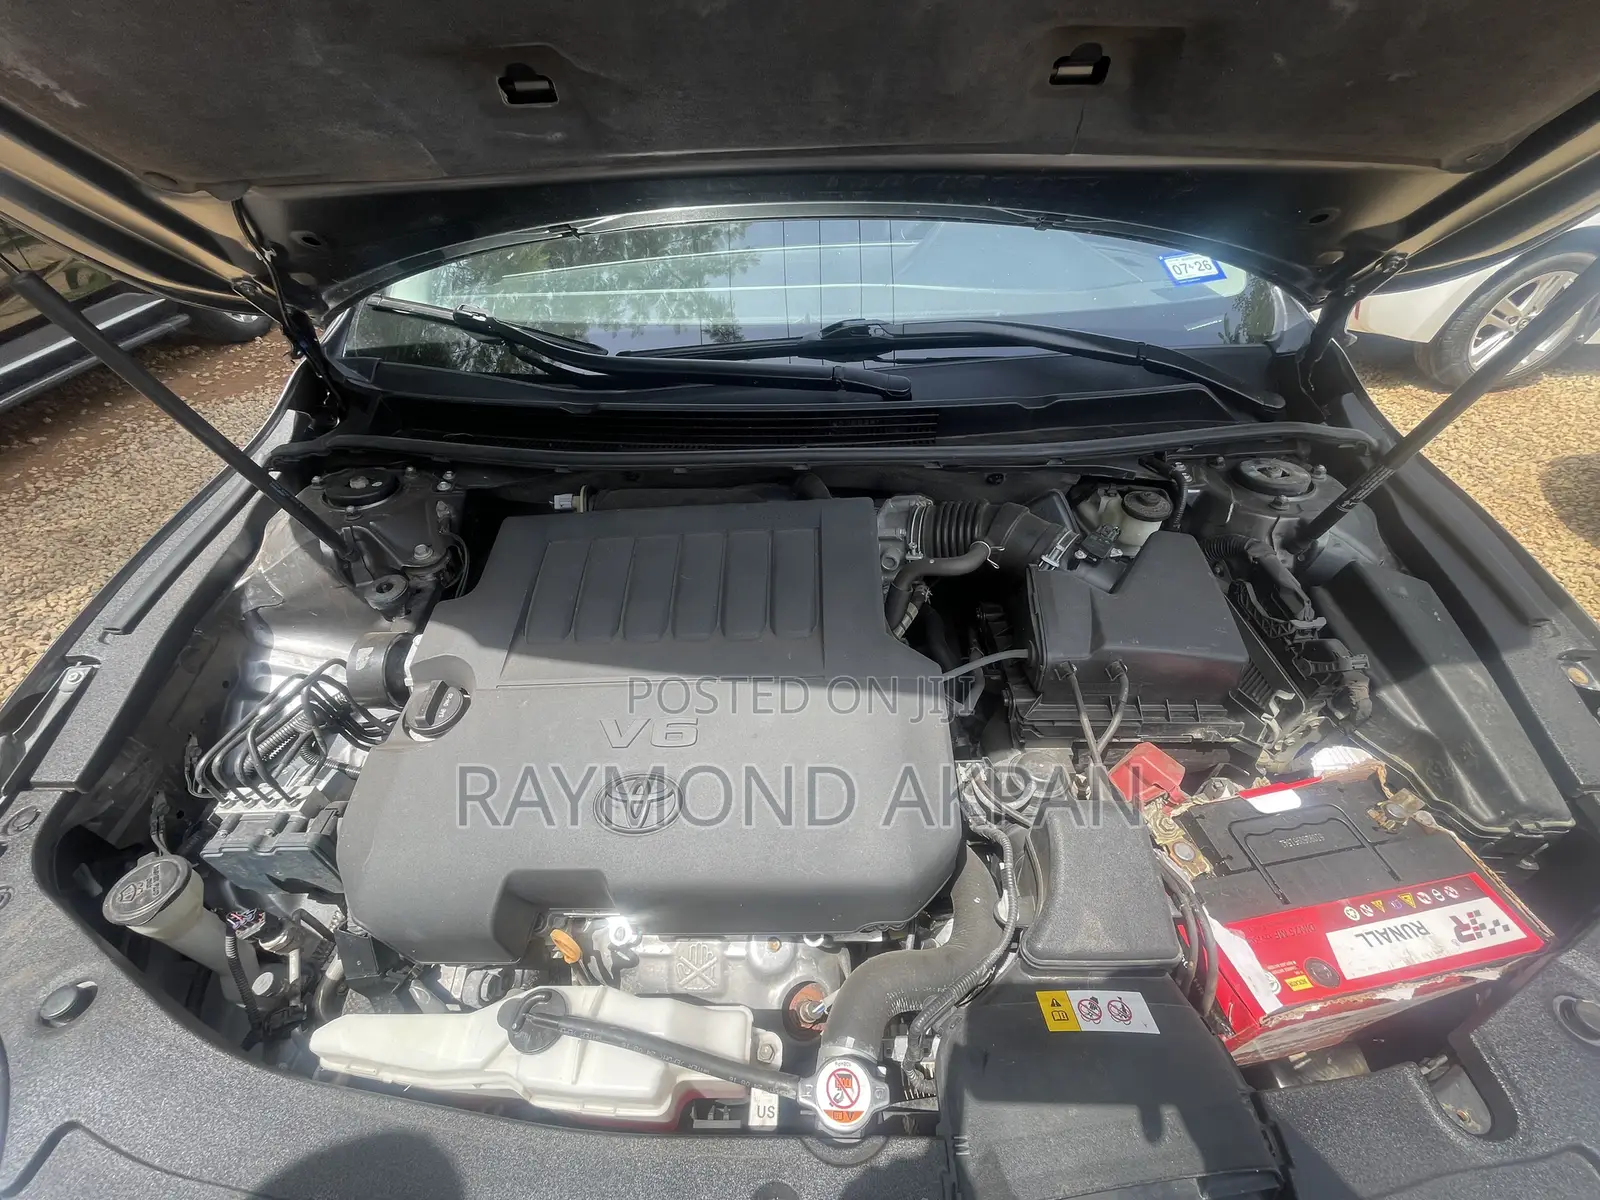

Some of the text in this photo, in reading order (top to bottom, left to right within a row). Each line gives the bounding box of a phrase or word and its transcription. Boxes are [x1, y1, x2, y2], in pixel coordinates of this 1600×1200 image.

[599, 718, 698, 748] V6
[1354, 920, 1431, 947] RUNALL
[756, 1105, 775, 1119] US
